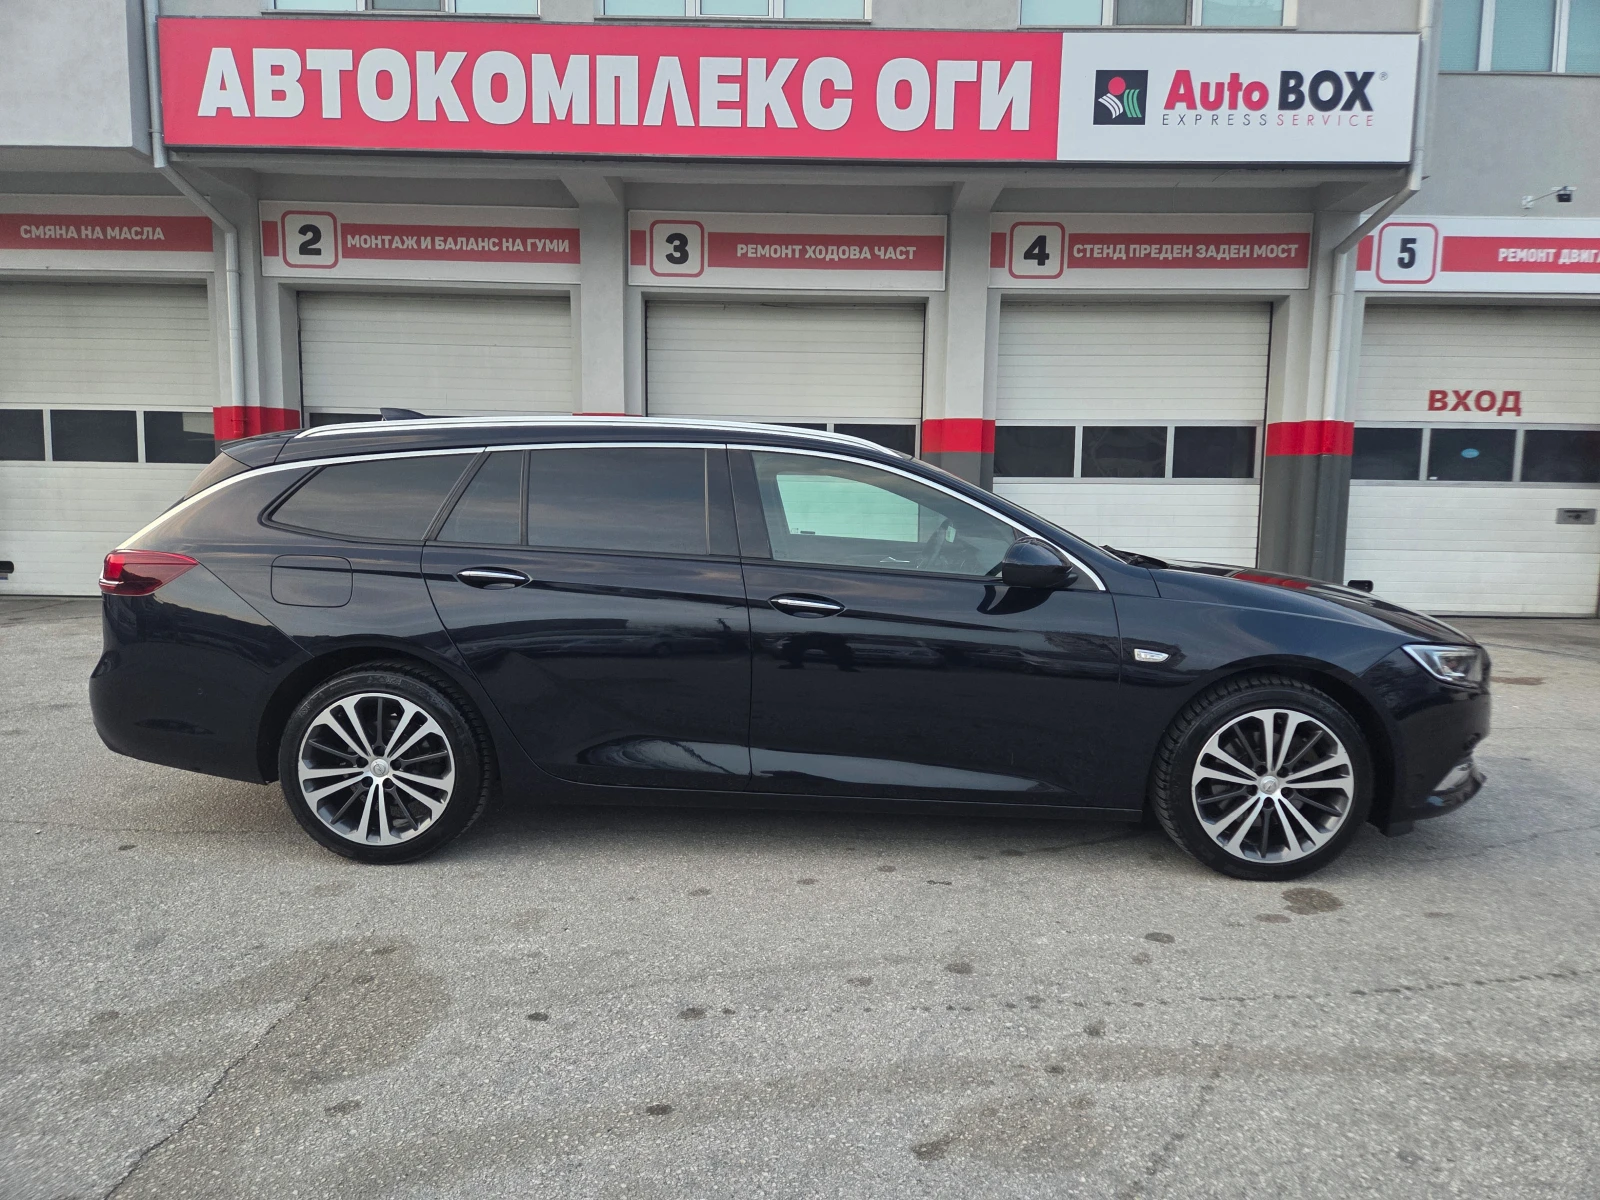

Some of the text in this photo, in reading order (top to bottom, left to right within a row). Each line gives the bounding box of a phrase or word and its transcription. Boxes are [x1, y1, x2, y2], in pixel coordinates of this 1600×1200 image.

[198, 48, 1033, 131] АВТОКОМПЛЕКС ОГИ
[1164, 69, 1269, 111] Auto
[20, 225, 165, 241] СМЯНА НА МАСЛА
[298, 223, 570, 256] 2 МОНТАЖ И БАЛАНС НА ГУМИ
[665, 232, 917, 265] 3 РЕМОНТ ХОДОВА ЧАСТ
[1023, 235, 1299, 266] 4 СТЕНД ПРЕДЕН ЗАДЕН МОСТ
[1397, 237, 1417, 270] 5
[1498, 248, 1557, 262] РЕМОНТ
[1428, 390, 1522, 416] ВХОД
